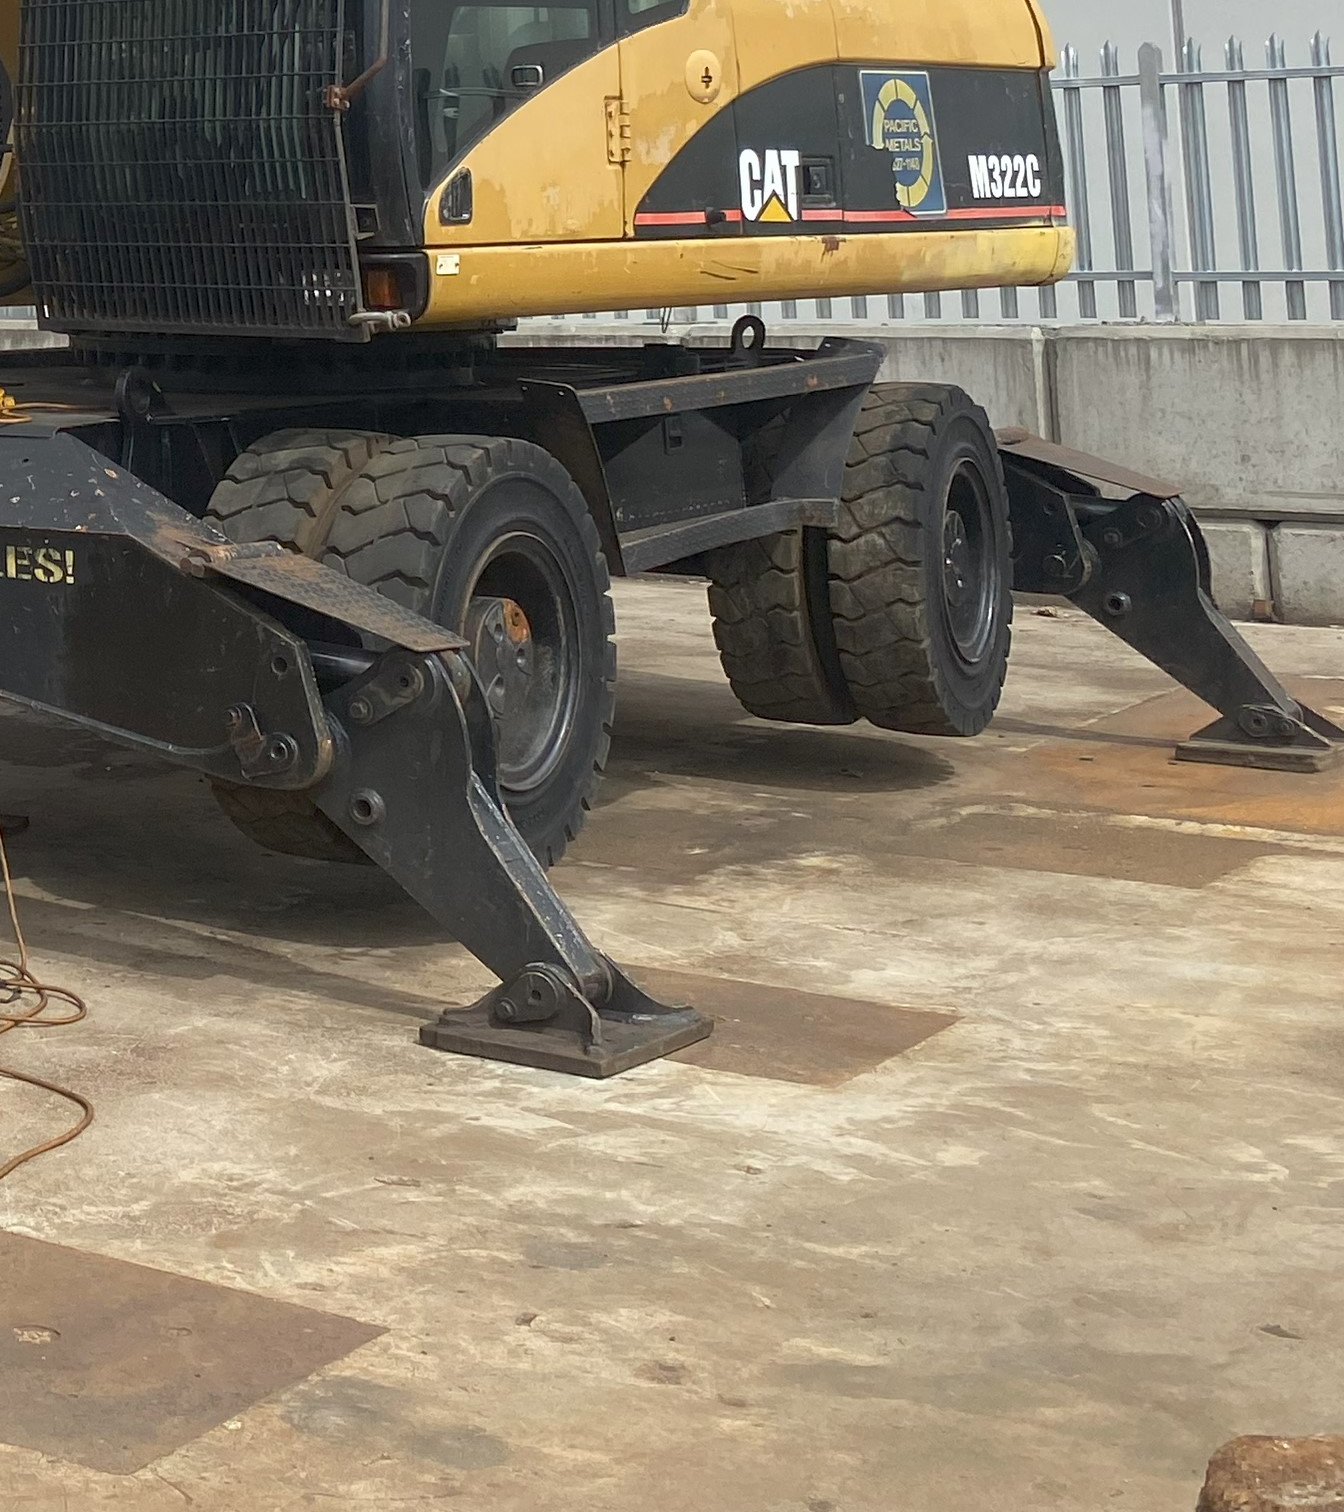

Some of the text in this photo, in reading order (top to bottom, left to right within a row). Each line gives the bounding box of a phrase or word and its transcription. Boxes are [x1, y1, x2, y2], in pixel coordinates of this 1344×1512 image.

[884, 119, 919, 133] PACIFIC
[884, 137, 922, 152] METALS
[738, 148, 801, 222] CAT
[967, 154, 1042, 199] M322C
